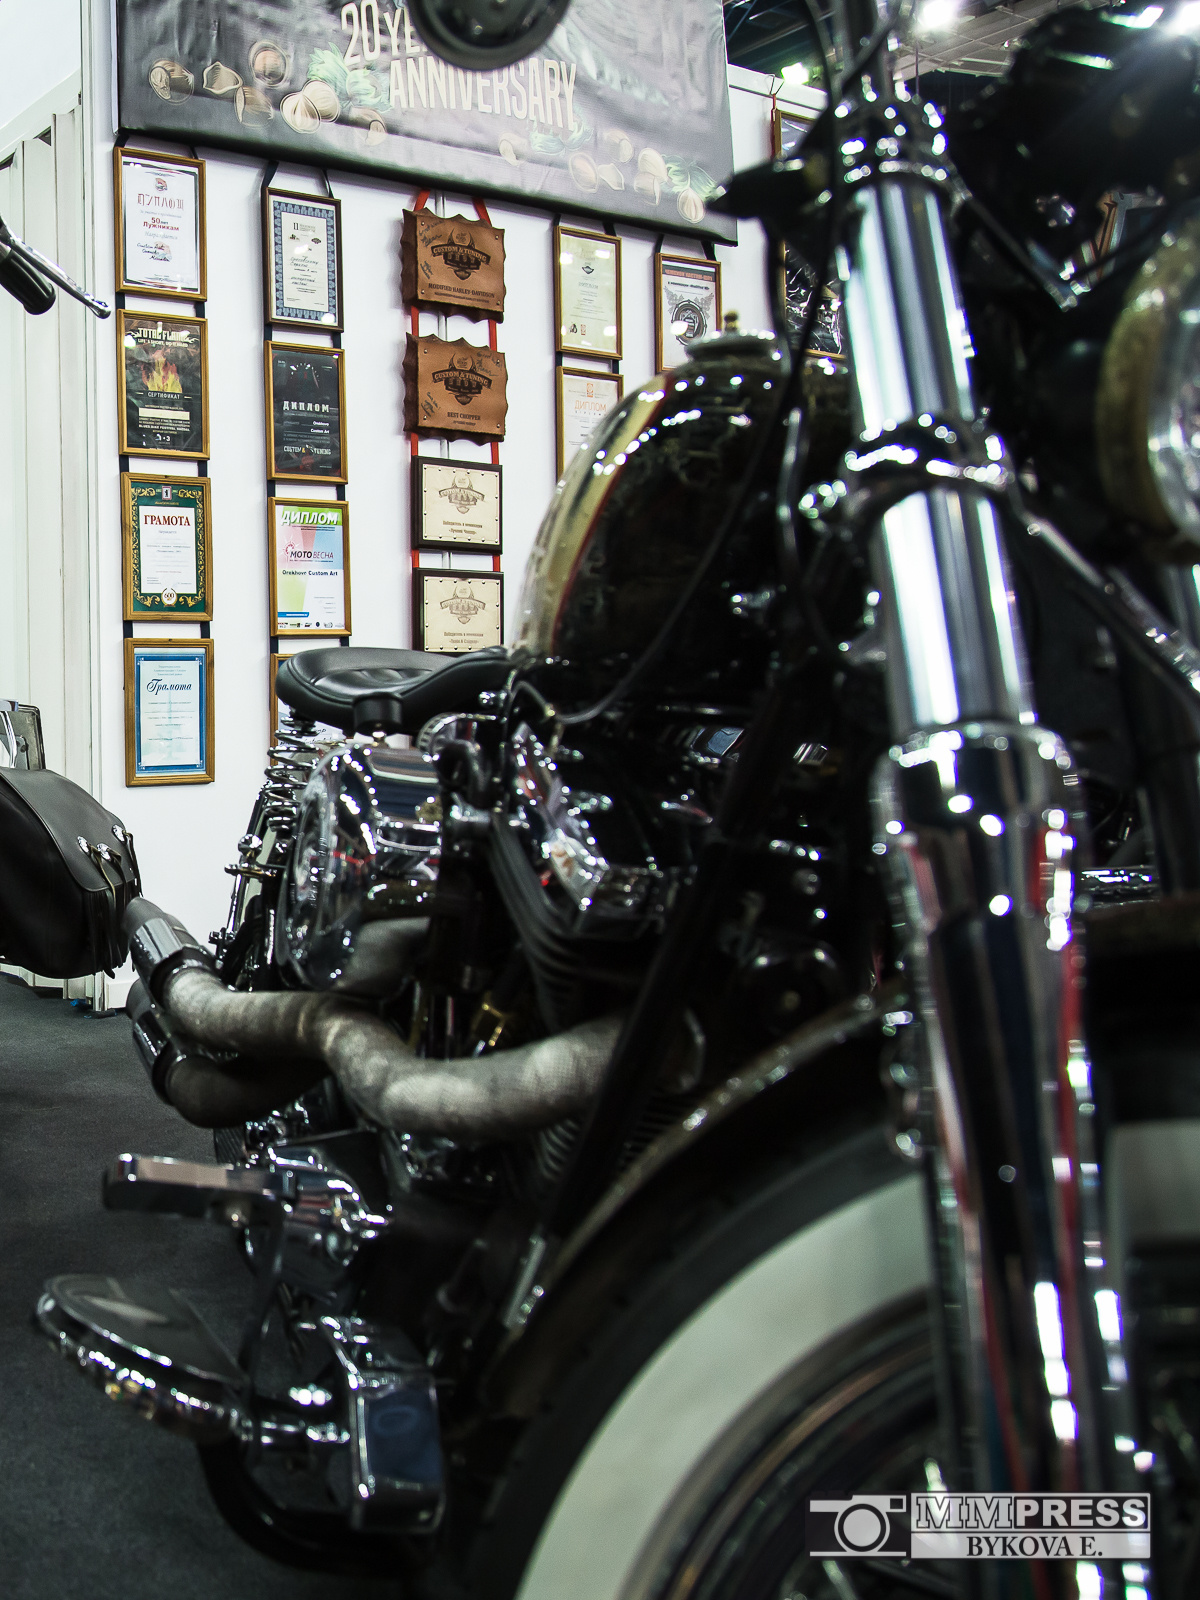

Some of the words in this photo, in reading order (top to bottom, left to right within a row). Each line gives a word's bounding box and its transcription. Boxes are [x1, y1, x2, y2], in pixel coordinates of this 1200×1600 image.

[341, 0, 381, 66] 20
[389, 56, 577, 131] ANNIVERSARY
[147, 391, 180, 399] СЕРТИФИКАТ
[283, 400, 329, 412] ДИПЛОМ
[144, 515, 191, 526] ГРАМОТА
[281, 510, 338, 526] ДИПЛОМ
[147, 678, 192, 695] Грамота
